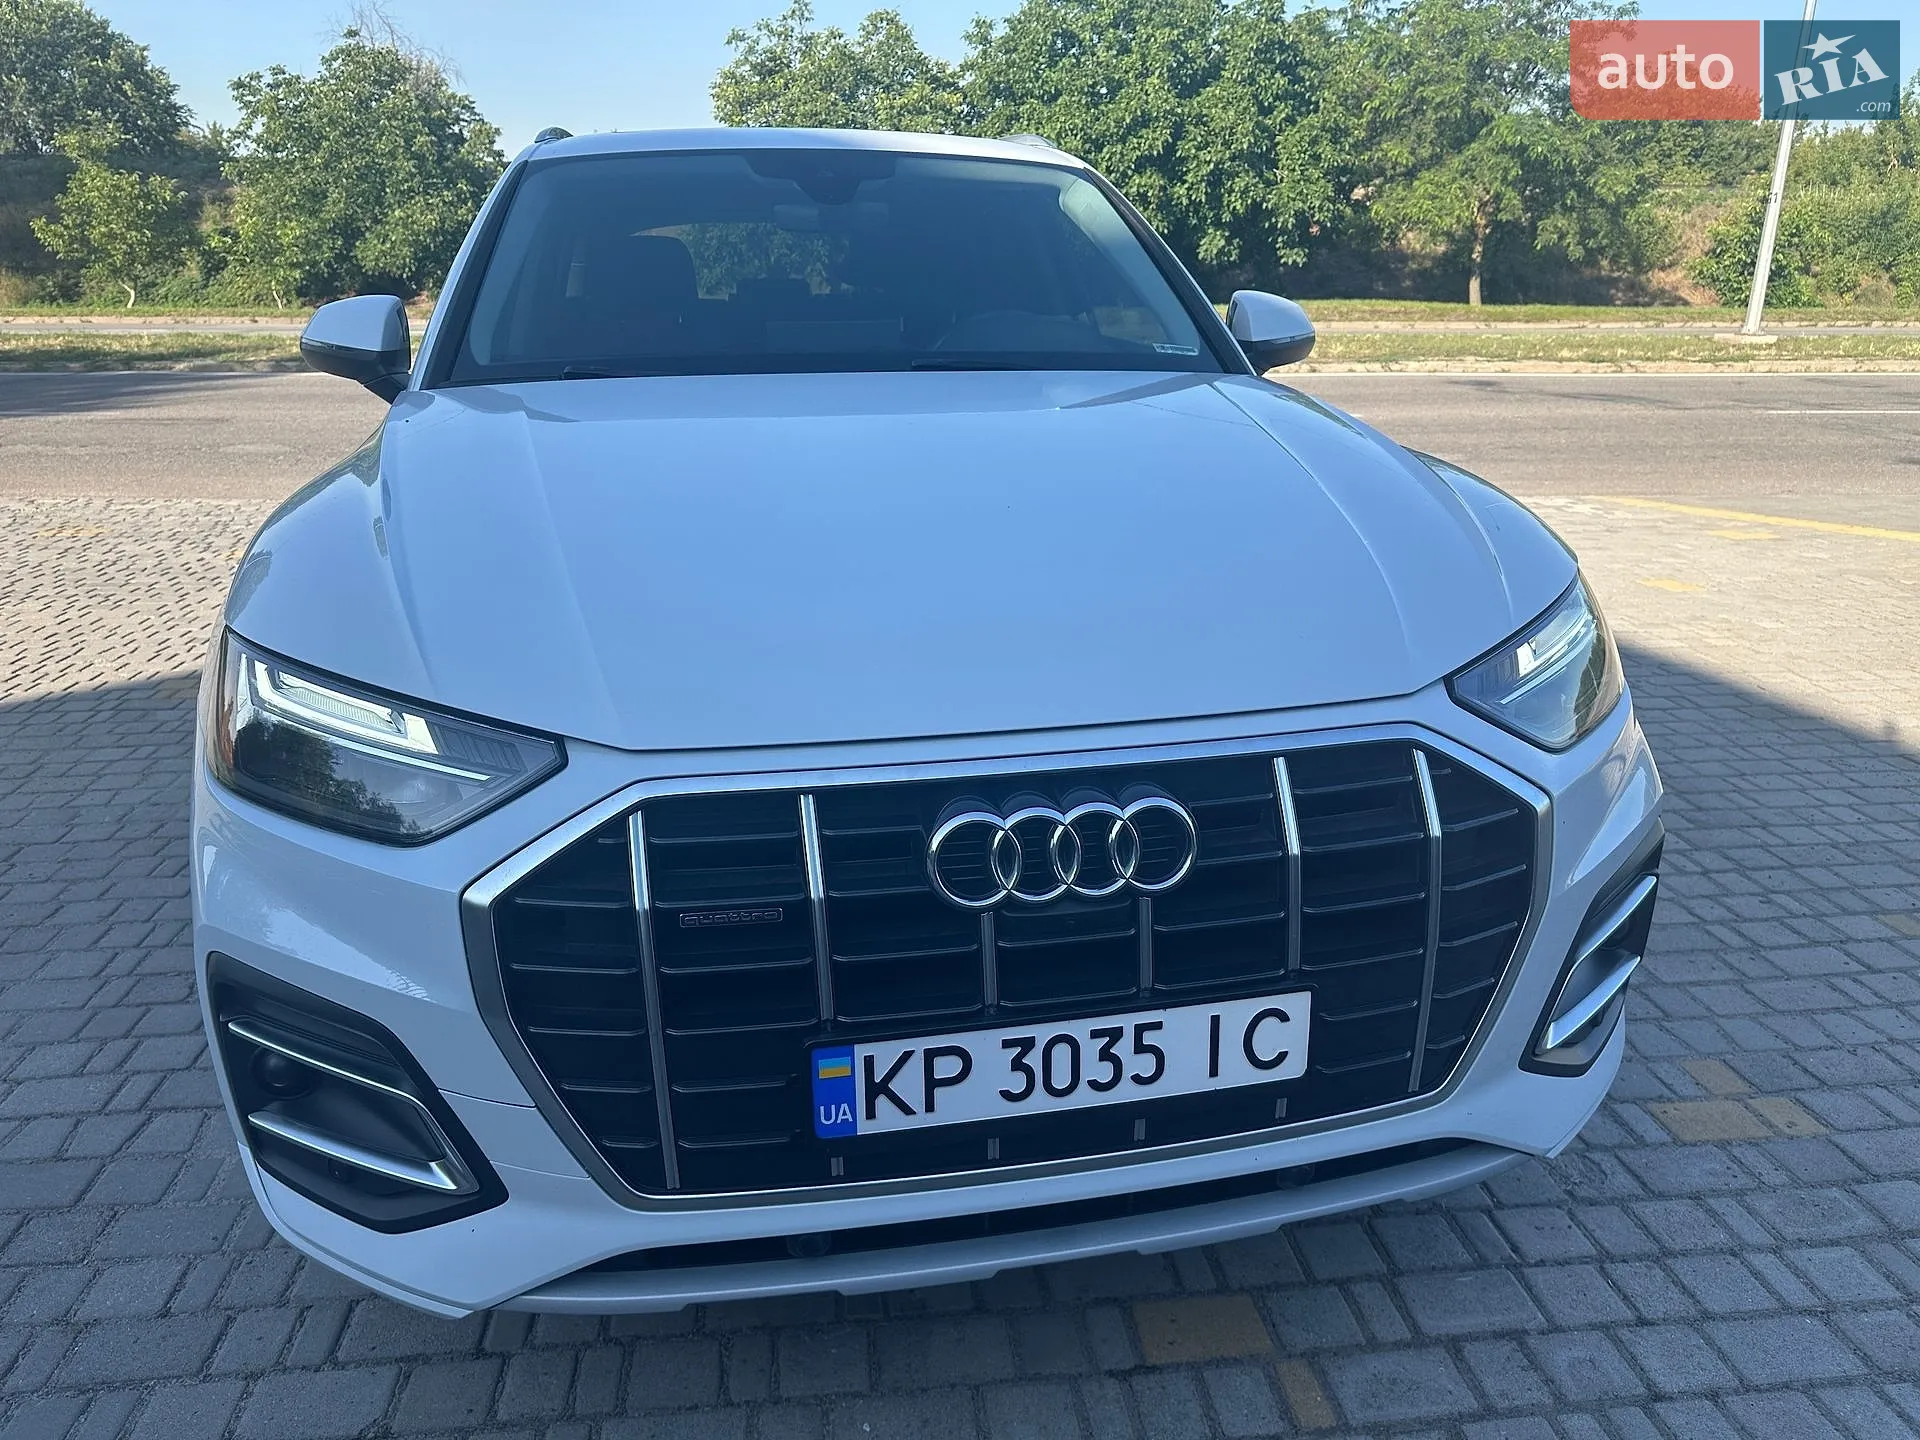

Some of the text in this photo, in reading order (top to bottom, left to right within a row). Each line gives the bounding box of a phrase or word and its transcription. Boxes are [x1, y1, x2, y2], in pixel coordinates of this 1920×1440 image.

[684, 911, 778, 926] quattro
[863, 1044, 973, 1120] KP
[998, 1020, 1165, 1102] 3035
[819, 1102, 854, 1125] UA
